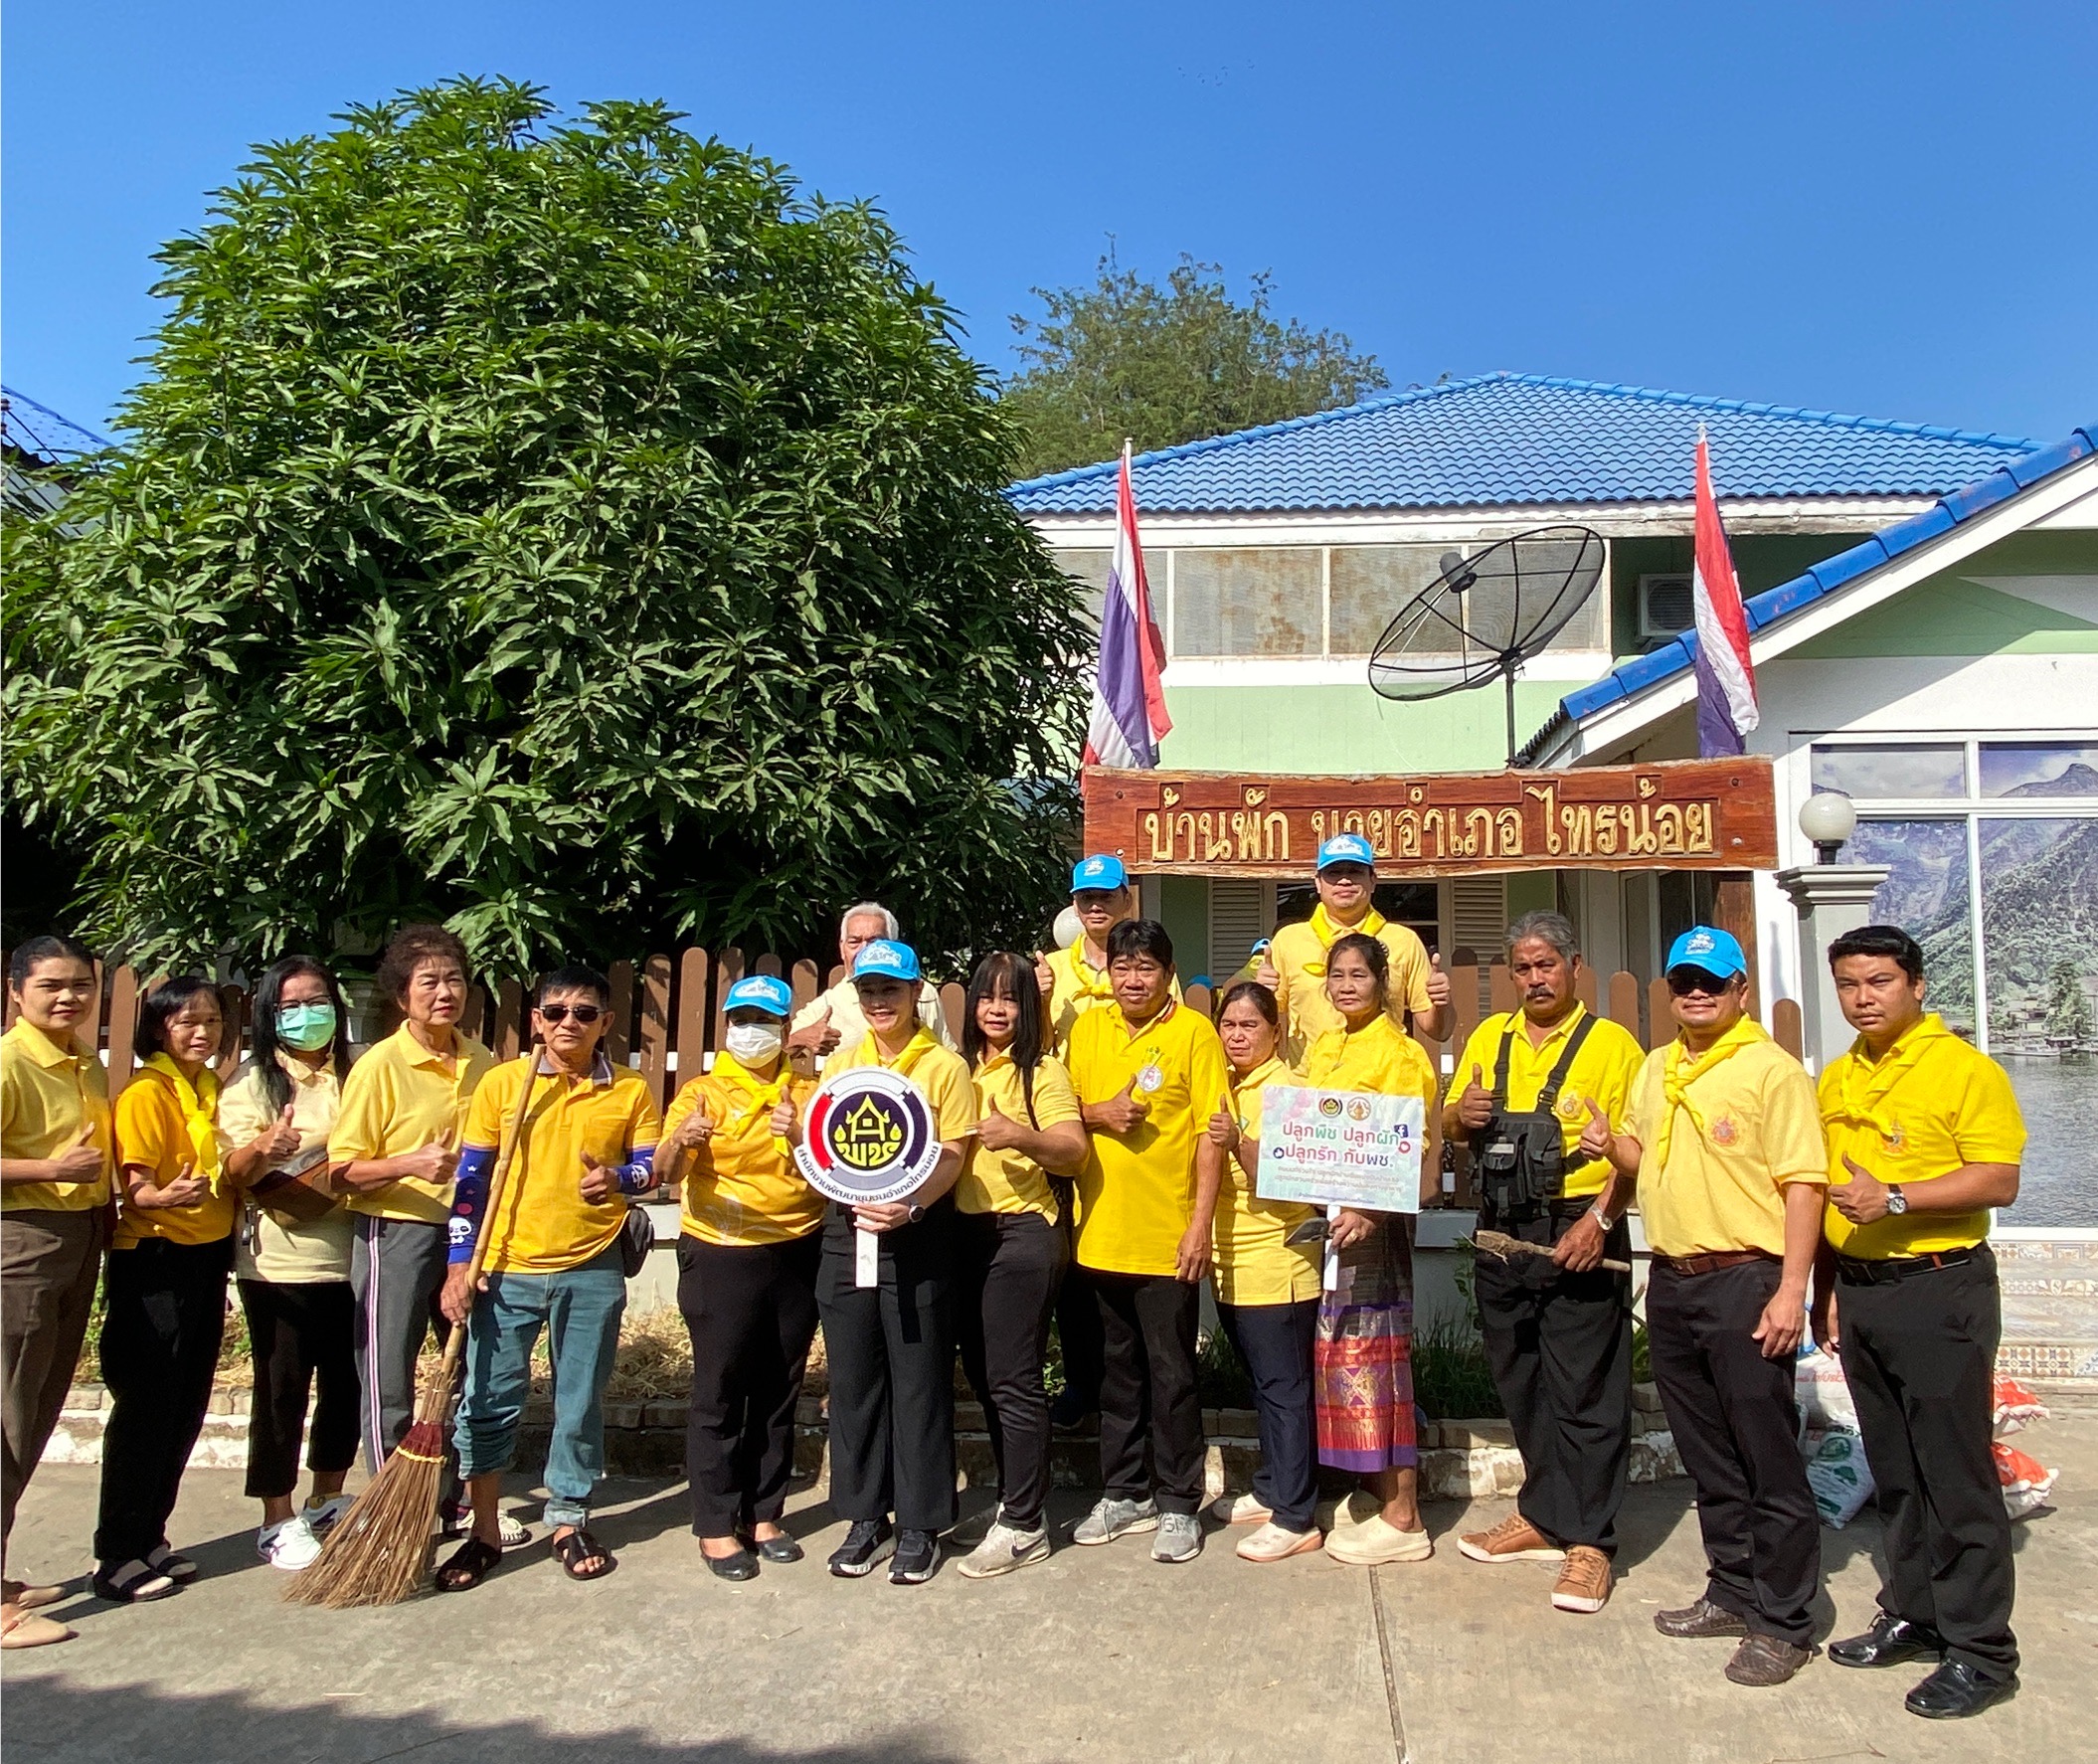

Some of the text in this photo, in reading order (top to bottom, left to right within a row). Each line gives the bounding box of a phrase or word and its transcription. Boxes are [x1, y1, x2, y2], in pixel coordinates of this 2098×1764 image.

[1144, 787, 1290, 861] บ้านพัก
[1524, 778, 1713, 855] ไทรน้อย
[1283, 1121, 1399, 1148] ปลูกพืช ปลูกผัก
[1286, 1144, 1337, 1164] ปลูกรัก
